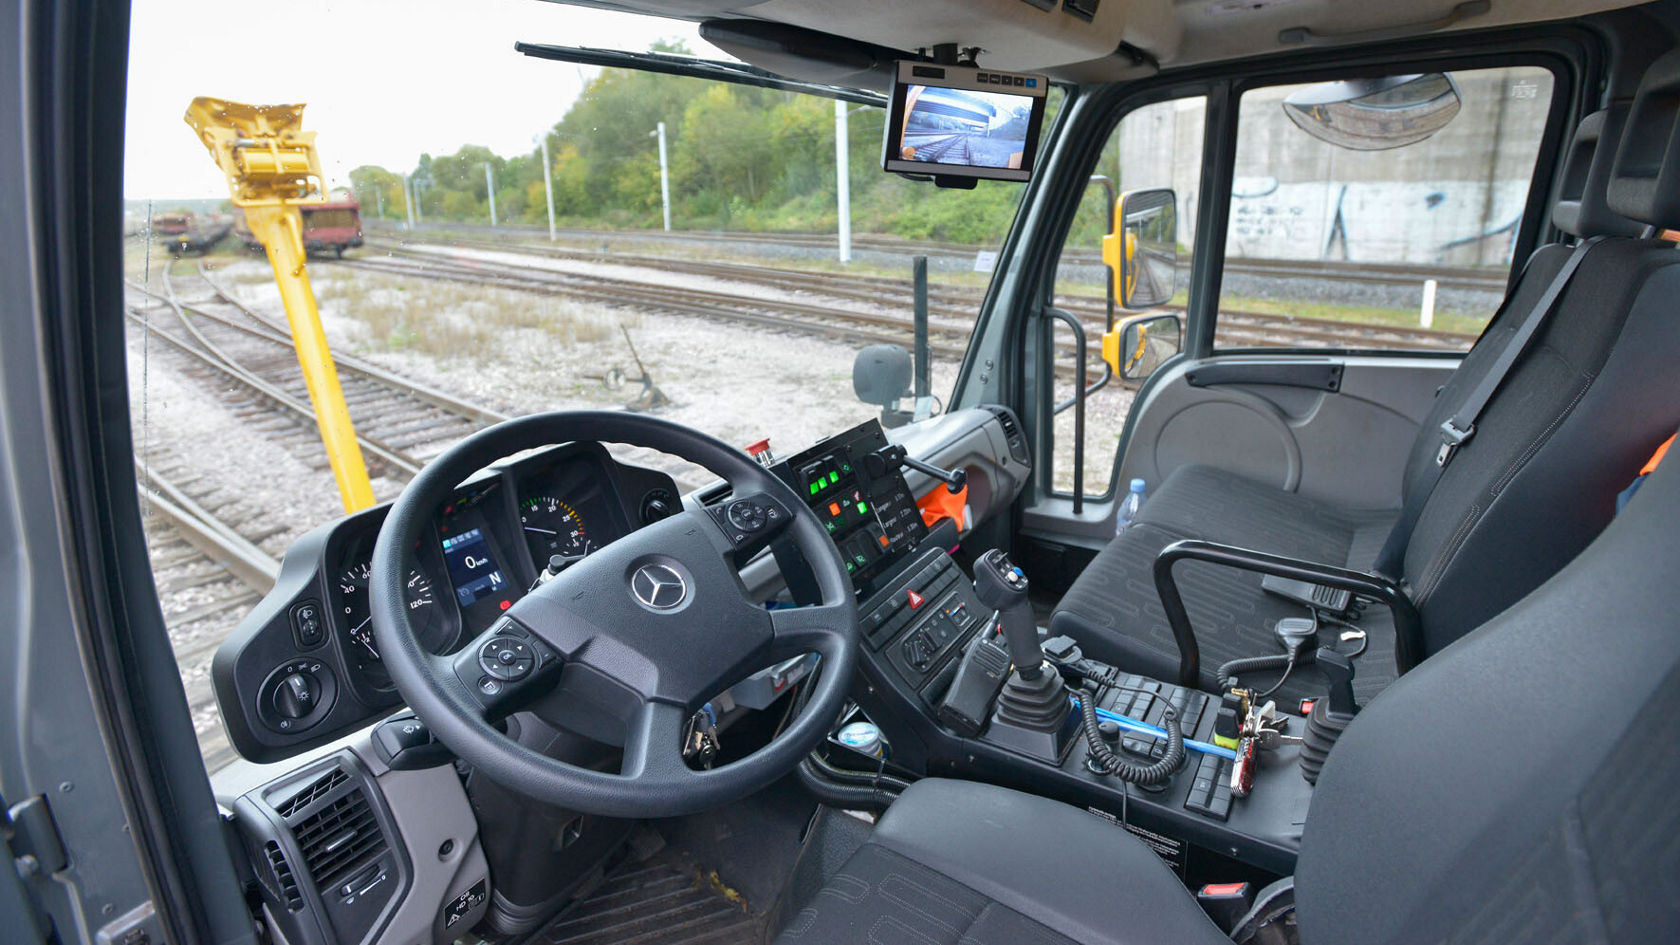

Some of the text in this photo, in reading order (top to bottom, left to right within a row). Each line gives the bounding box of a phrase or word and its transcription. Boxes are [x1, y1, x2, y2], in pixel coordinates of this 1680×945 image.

[570, 530, 578, 538] 30
[465, 555, 476, 569] 0
[489, 571, 502, 585] N
[344, 585, 355, 593] 40
[410, 599, 423, 609] 120
